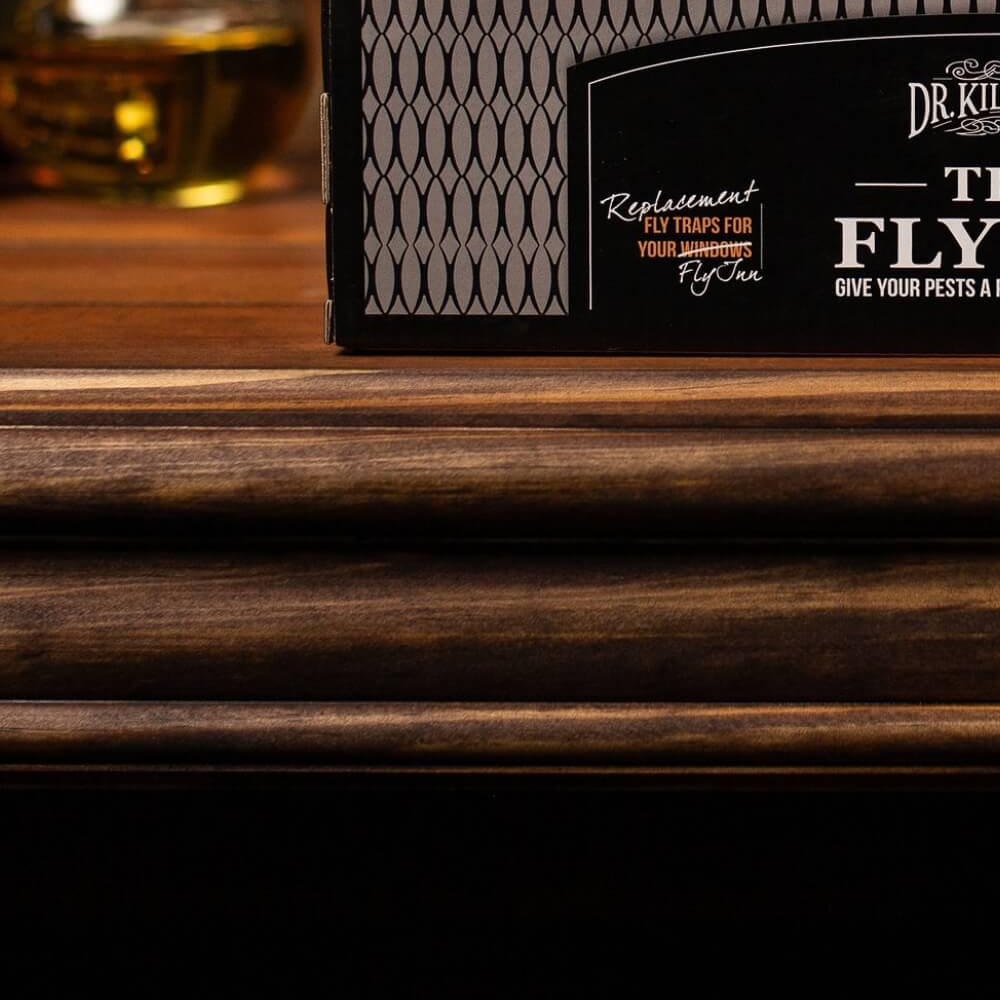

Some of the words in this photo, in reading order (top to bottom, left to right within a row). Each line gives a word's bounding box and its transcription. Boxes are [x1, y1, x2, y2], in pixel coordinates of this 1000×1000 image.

[600, 179, 760, 222] Replacement
[644, 216, 669, 234] FLY
[673, 216, 721, 234] TRAPS
[724, 216, 752, 234] FOR
[638, 240, 677, 258] YOUR
[679, 240, 752, 258] WINDOWS
[834, 217, 1000, 269] FLY
[678, 260, 716, 297] Fly
[835, 278, 873, 298] GIVE
[876, 278, 921, 298] YOUR
[924, 278, 976, 298] PESTS
[980, 278, 992, 298] A
